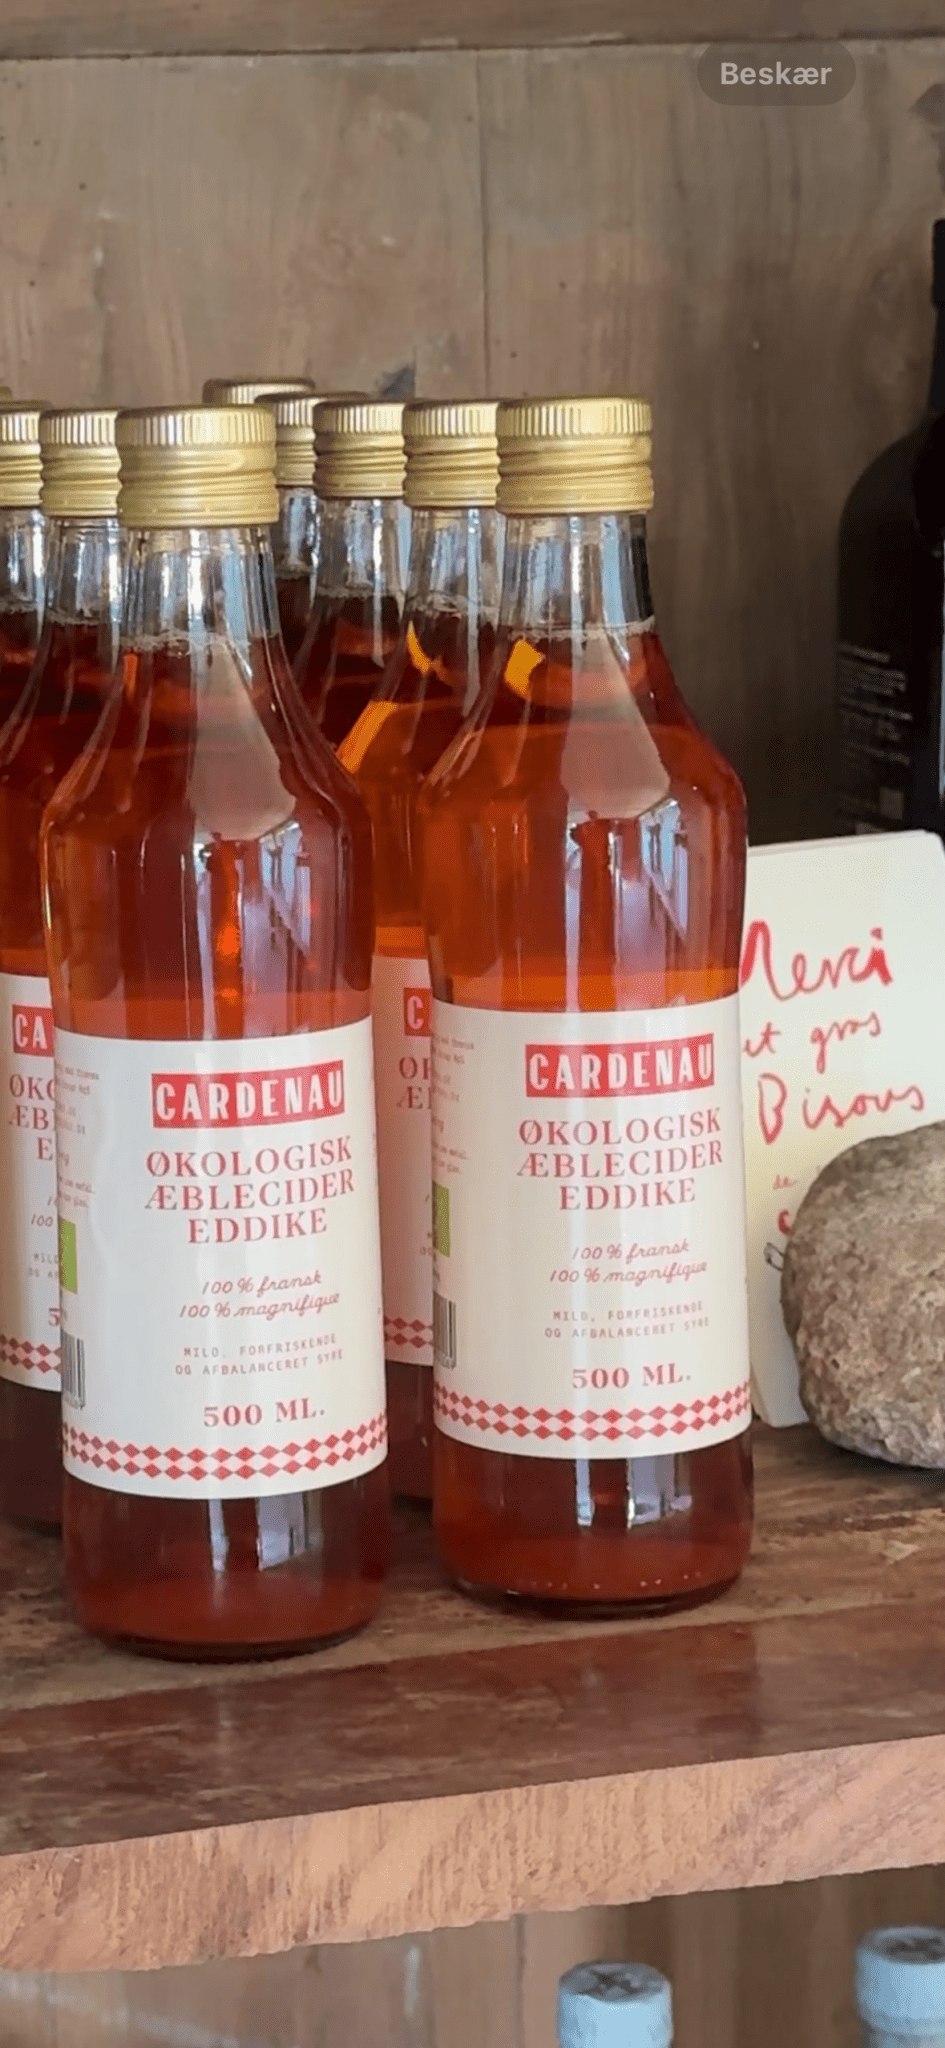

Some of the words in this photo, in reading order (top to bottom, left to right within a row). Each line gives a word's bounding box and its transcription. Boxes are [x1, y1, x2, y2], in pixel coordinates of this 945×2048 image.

[739, 919, 893, 1002] Merci
[742, 1022, 781, 1058] et
[810, 1011, 882, 1074] gros
[529, 1043, 713, 1091] CARDENAU
[155, 1069, 343, 1121] CARDENAU
[518, 1107, 721, 1146] ØKOLOGISK
[146, 1135, 353, 1178] ØKOLOGISK
[517, 1139, 723, 1178] ÆBLECIDER
[144, 1167, 355, 1210] ÆBLECIDER
[559, 1177, 696, 1211] EDDIKE
[31, 1214, 54, 1227] 100
[187, 1207, 328, 1244] EDDIKE
[571, 1246, 603, 1260] 100
[624, 1238, 690, 1264] fransk
[201, 1280, 233, 1295] 100
[256, 1269, 322, 1298] fransk
[549, 1269, 580, 1283] 100
[602, 1261, 708, 1287] magnifique
[179, 1303, 210, 1318] 100
[233, 1292, 340, 1321] magnifique
[607, 1300, 703, 1321] FORFRISKENDE
[239, 1333, 336, 1356] FORFRISKENDE
[544, 1327, 562, 1339] OG
[571, 1322, 675, 1339] AFBALANCERET
[175, 1364, 192, 1376] OG
[202, 1356, 308, 1376] AFBALANCERET
[317, 1348, 343, 1365] SYRE
[571, 1367, 630, 1390] 500
[642, 1363, 692, 1387] ML.
[203, 1403, 263, 1428] 500
[274, 1397, 326, 1423] ML.
